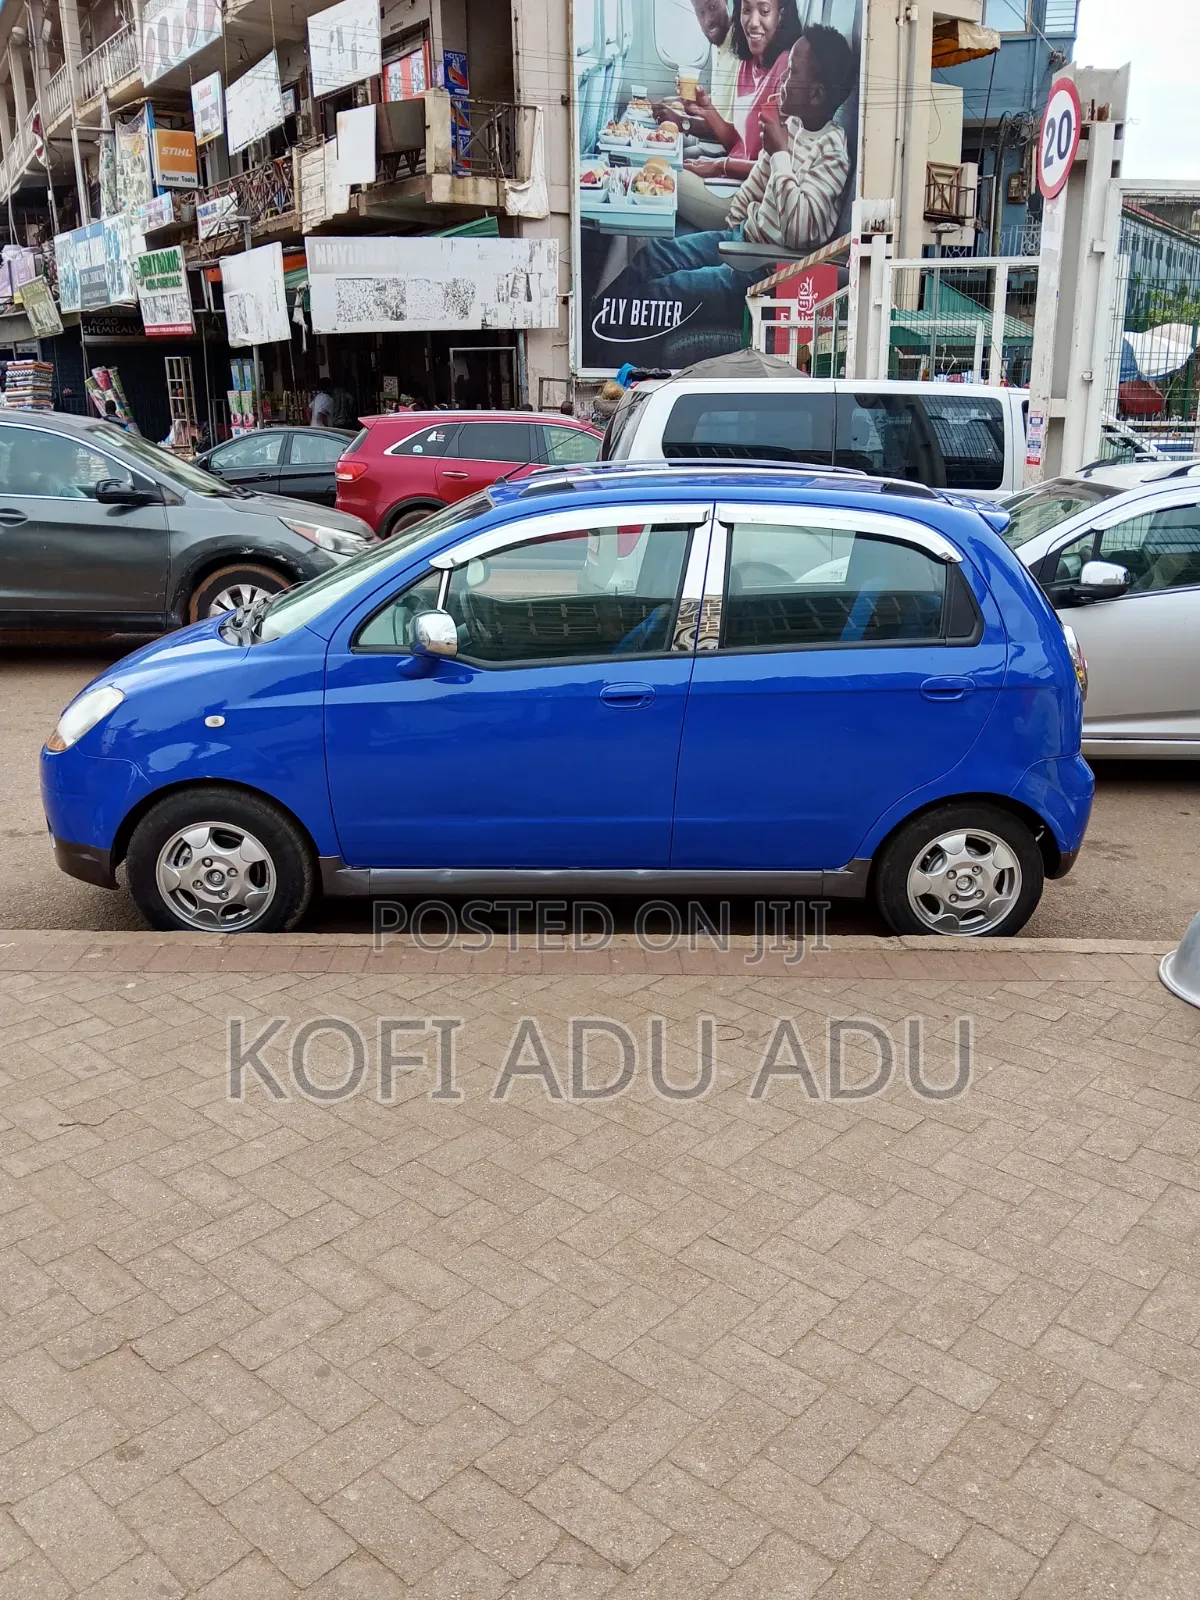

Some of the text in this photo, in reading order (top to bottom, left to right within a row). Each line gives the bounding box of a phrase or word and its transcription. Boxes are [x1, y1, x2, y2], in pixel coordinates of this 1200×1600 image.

[1044, 109, 1072, 169] 20
[161, 147, 192, 157] STIHL
[162, 174, 196, 183] Power Tools
[601, 298, 683, 327] FLY BETTER
[91, 317, 118, 326] AGRO
